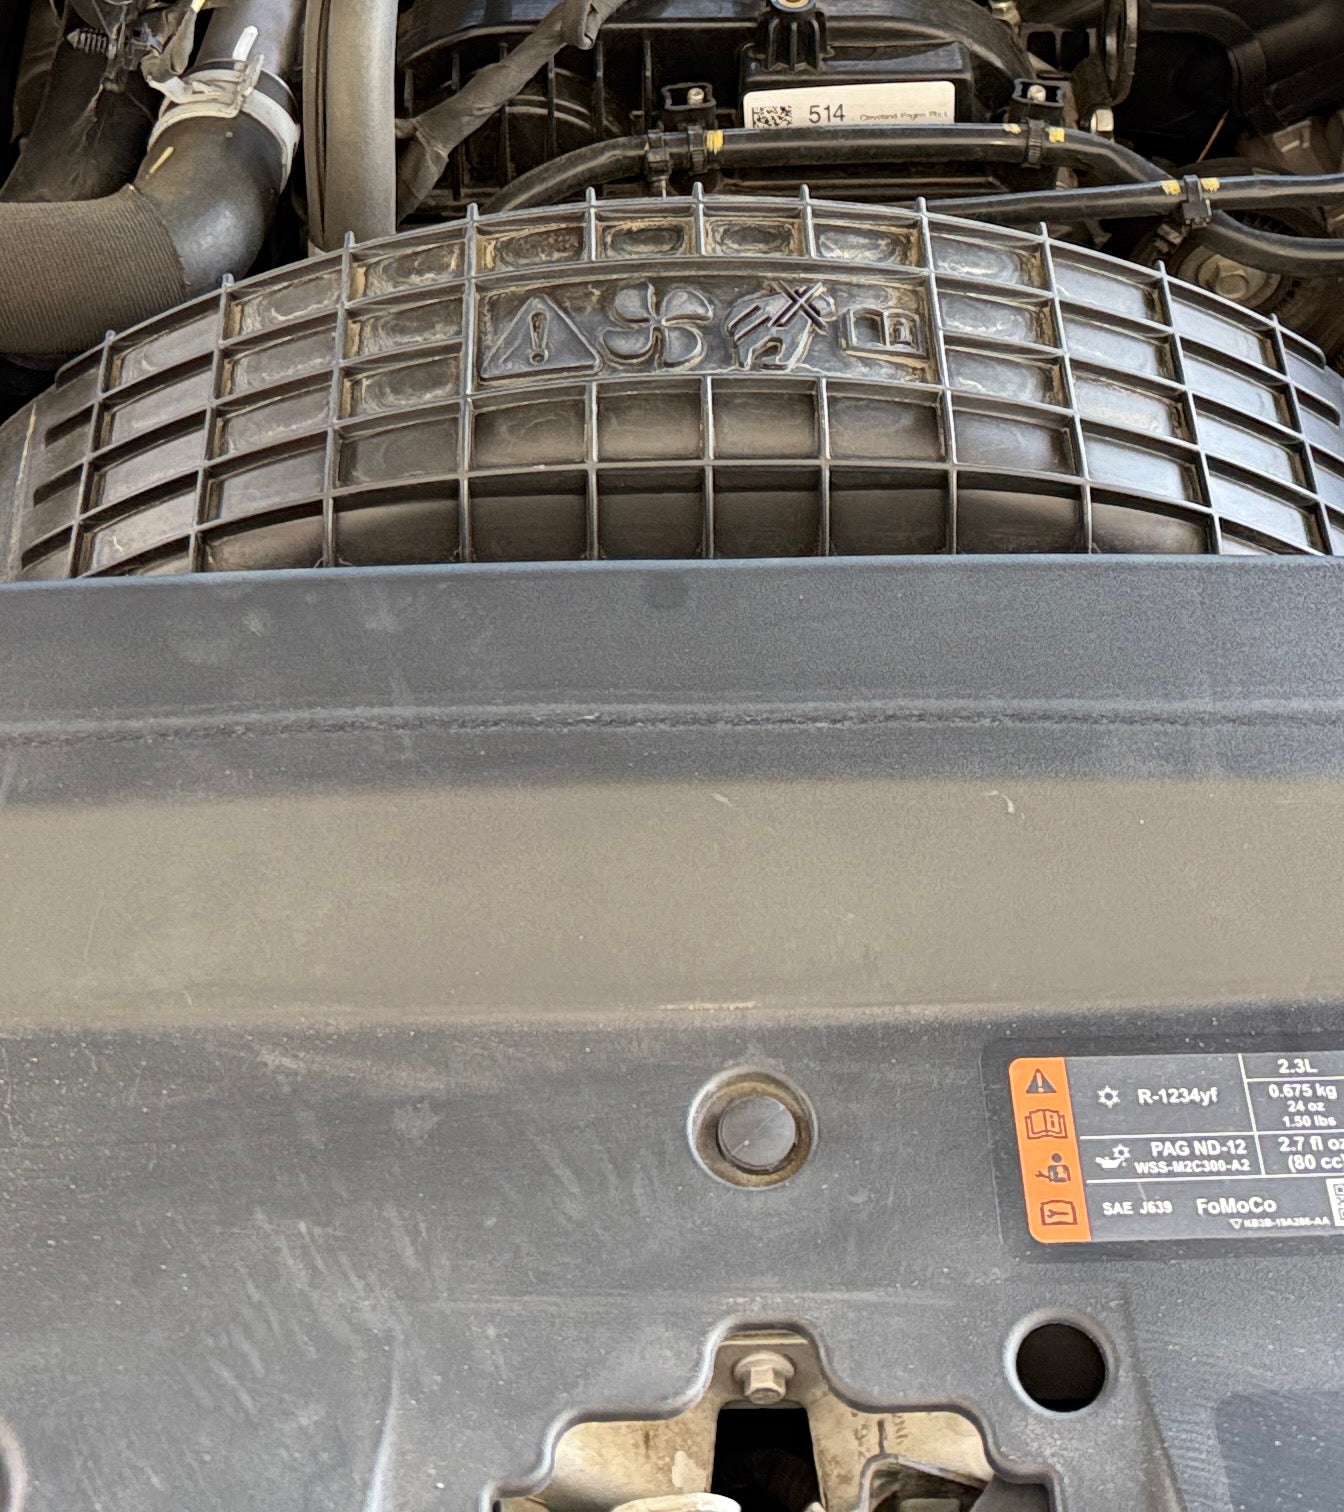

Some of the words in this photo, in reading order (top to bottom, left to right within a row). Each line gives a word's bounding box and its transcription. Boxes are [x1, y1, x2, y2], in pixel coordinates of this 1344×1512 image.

[808, 104, 845, 124] 514
[1277, 1058, 1319, 1074] 2.3L
[1137, 1086, 1218, 1106] R-1234yf
[1268, 1083, 1313, 1098] 0.675
[1315, 1082, 1338, 1100] kg
[1286, 1099, 1305, 1112] 24
[1307, 1101, 1326, 1112] oz
[1282, 1114, 1311, 1128] 1.50
[1313, 1114, 1337, 1126] lbs
[1151, 1140, 1190, 1157] PAG
[1193, 1139, 1248, 1156] ND-12
[1277, 1135, 1305, 1152] 2.7
[1309, 1135, 1324, 1151] fl
[1134, 1159, 1251, 1174] WSS-M2C300-A2
[1287, 1153, 1317, 1173] (80
[1102, 1201, 1134, 1216] SAE
[1139, 1200, 1173, 1215] J639
[1196, 1196, 1278, 1216] FoMoCo
